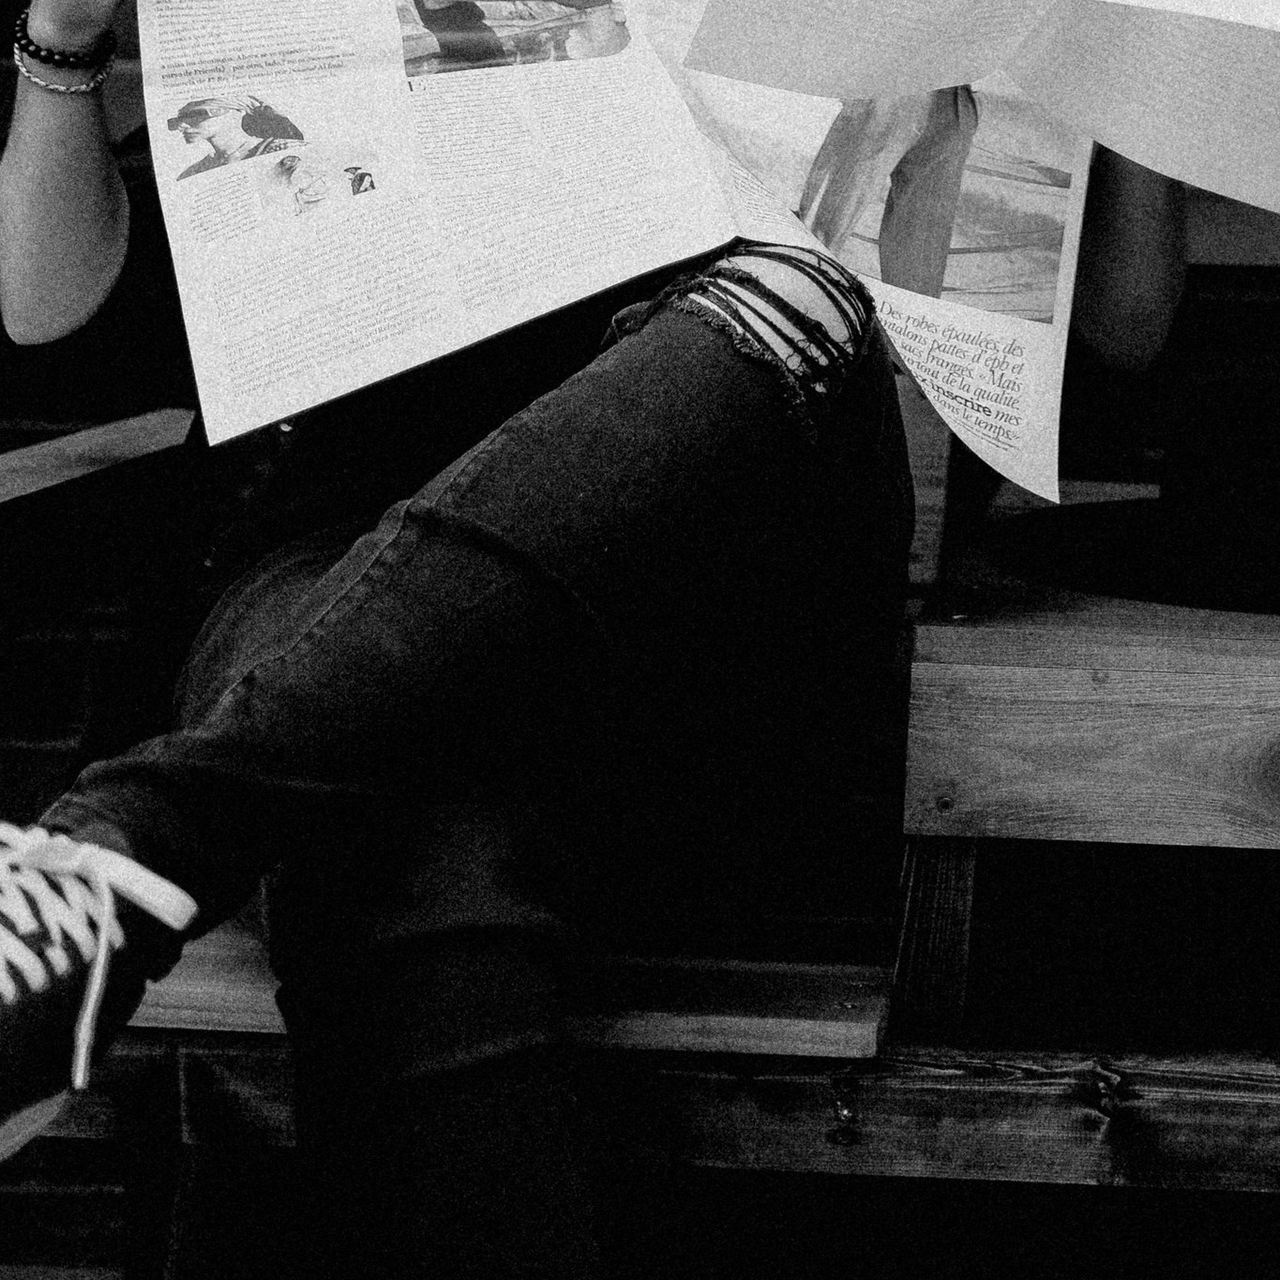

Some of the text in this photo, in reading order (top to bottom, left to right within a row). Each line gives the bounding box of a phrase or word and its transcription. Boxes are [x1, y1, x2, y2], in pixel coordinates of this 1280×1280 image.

[880, 301, 903, 321] Des
[906, 315, 940, 333] robes
[1003, 339, 1026, 357] des
[900, 343, 922, 357] sacs
[932, 339, 968, 360] pattes
[1011, 363, 1025, 375] et
[942, 372, 957, 387] de
[960, 377, 971, 393] la
[933, 393, 960, 415] dans
[963, 407, 972, 421] le
[994, 410, 1022, 427] mes
